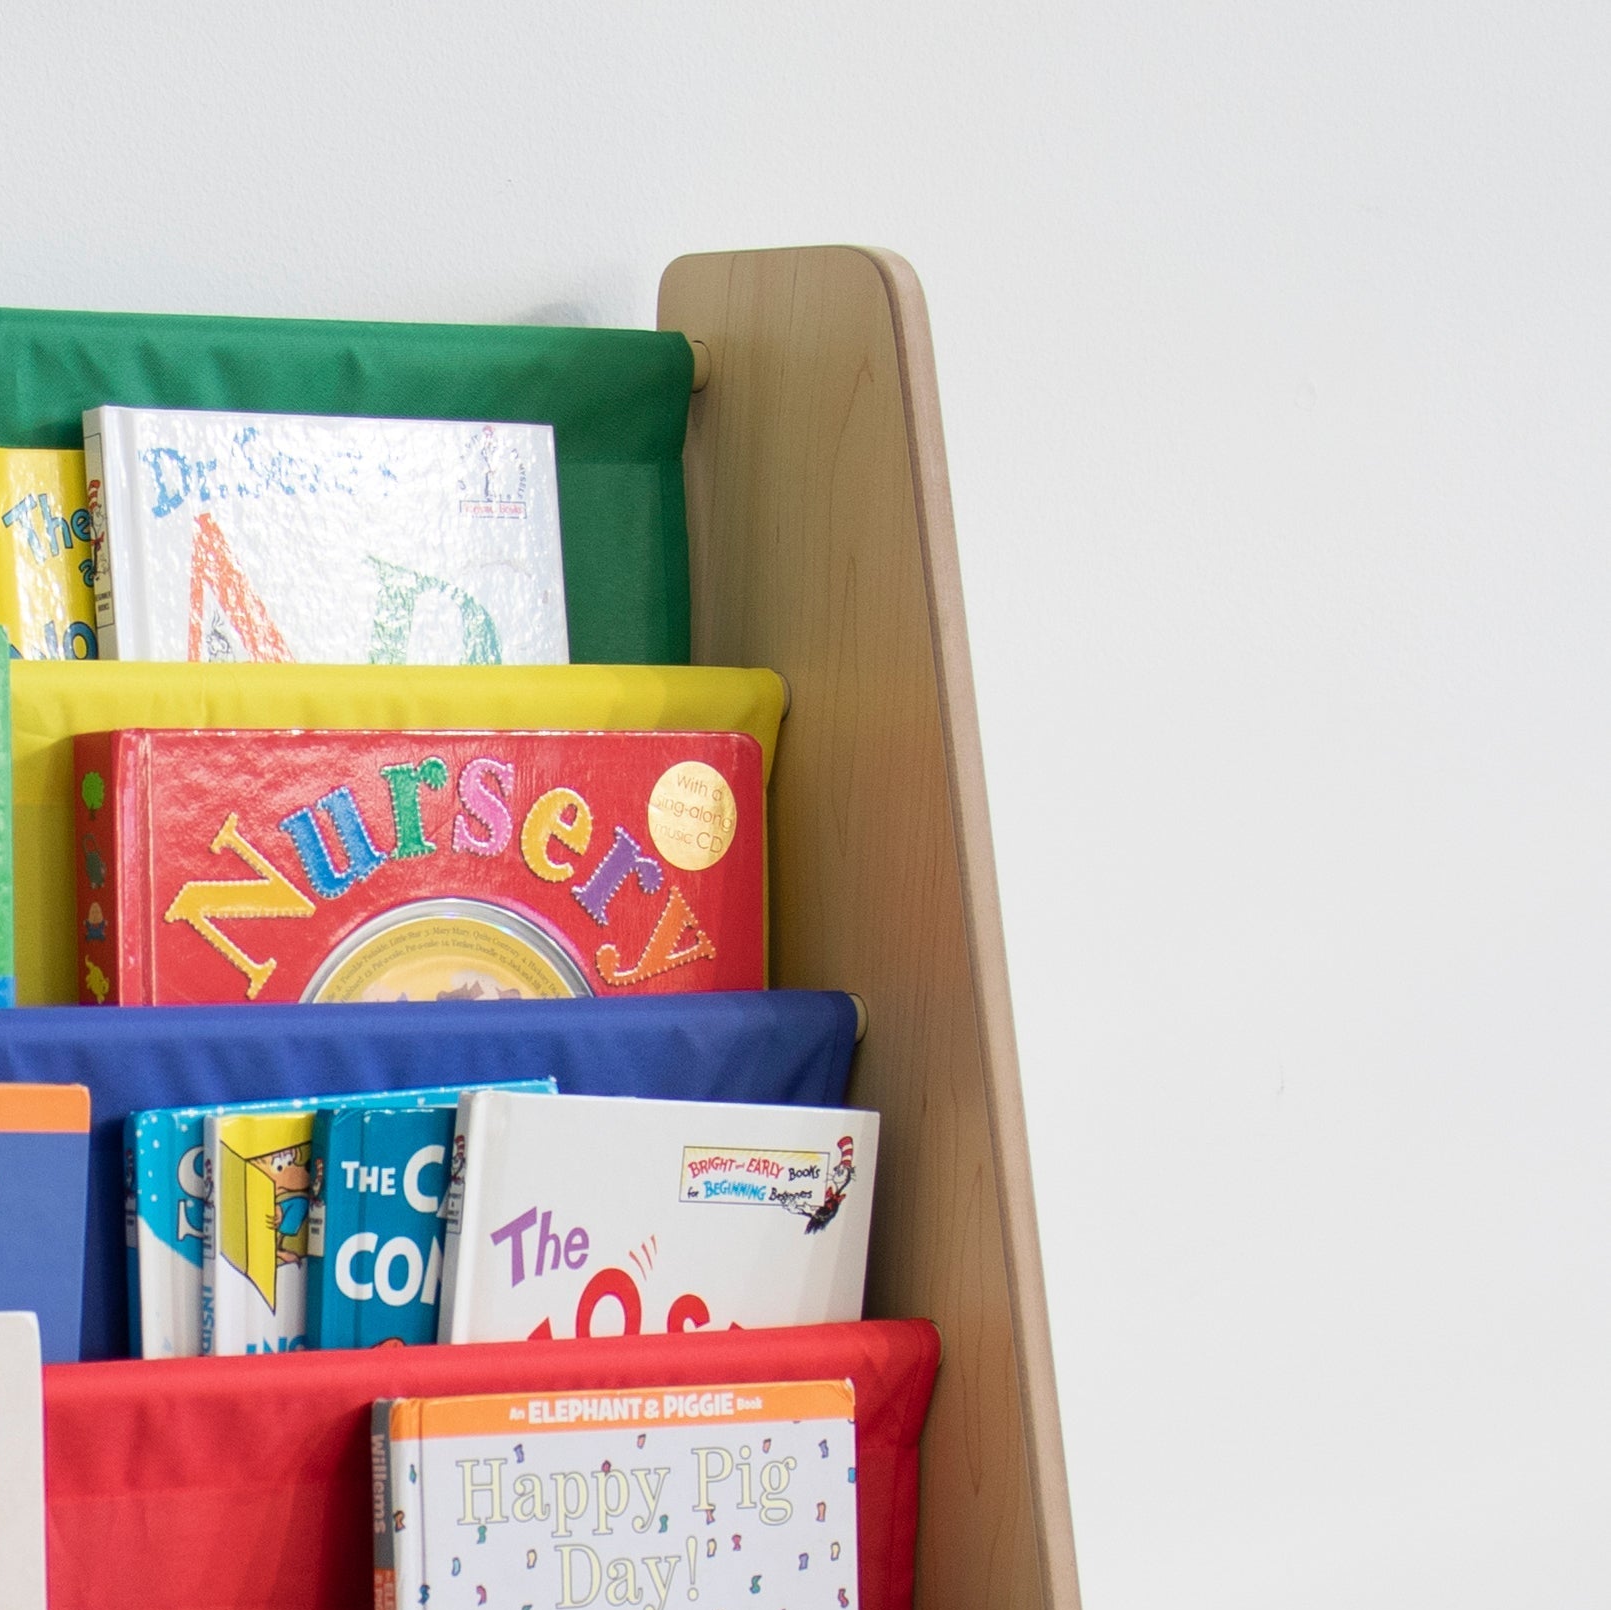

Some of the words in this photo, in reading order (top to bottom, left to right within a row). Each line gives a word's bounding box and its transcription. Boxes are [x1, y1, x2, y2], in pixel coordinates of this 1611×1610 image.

[677, 773, 708, 798] With
[712, 788, 723, 801] a
[653, 794, 733, 833] sing-along
[654, 823, 694, 845] music
[696, 831, 724, 853] CD
[164, 756, 717, 1000] Nursery
[341, 1160, 397, 1196] THE
[688, 1156, 737, 1179] BRIGHT
[746, 1157, 784, 1179] EARLY
[687, 1186, 699, 1199] for
[703, 1179, 766, 1201] BEGINNING
[490, 1206, 590, 1289] The
[509, 1407, 525, 1421] An
[528, 1397, 644, 1425] ELEPHANT
[643, 1400, 660, 1420] &
[663, 1392, 735, 1419] PIGGIE
[736, 1396, 763, 1411] Book
[371, 1433, 387, 1535] Willems
[455, 1456, 672, 1538] Happy
[690, 1443, 798, 1526] Pig
